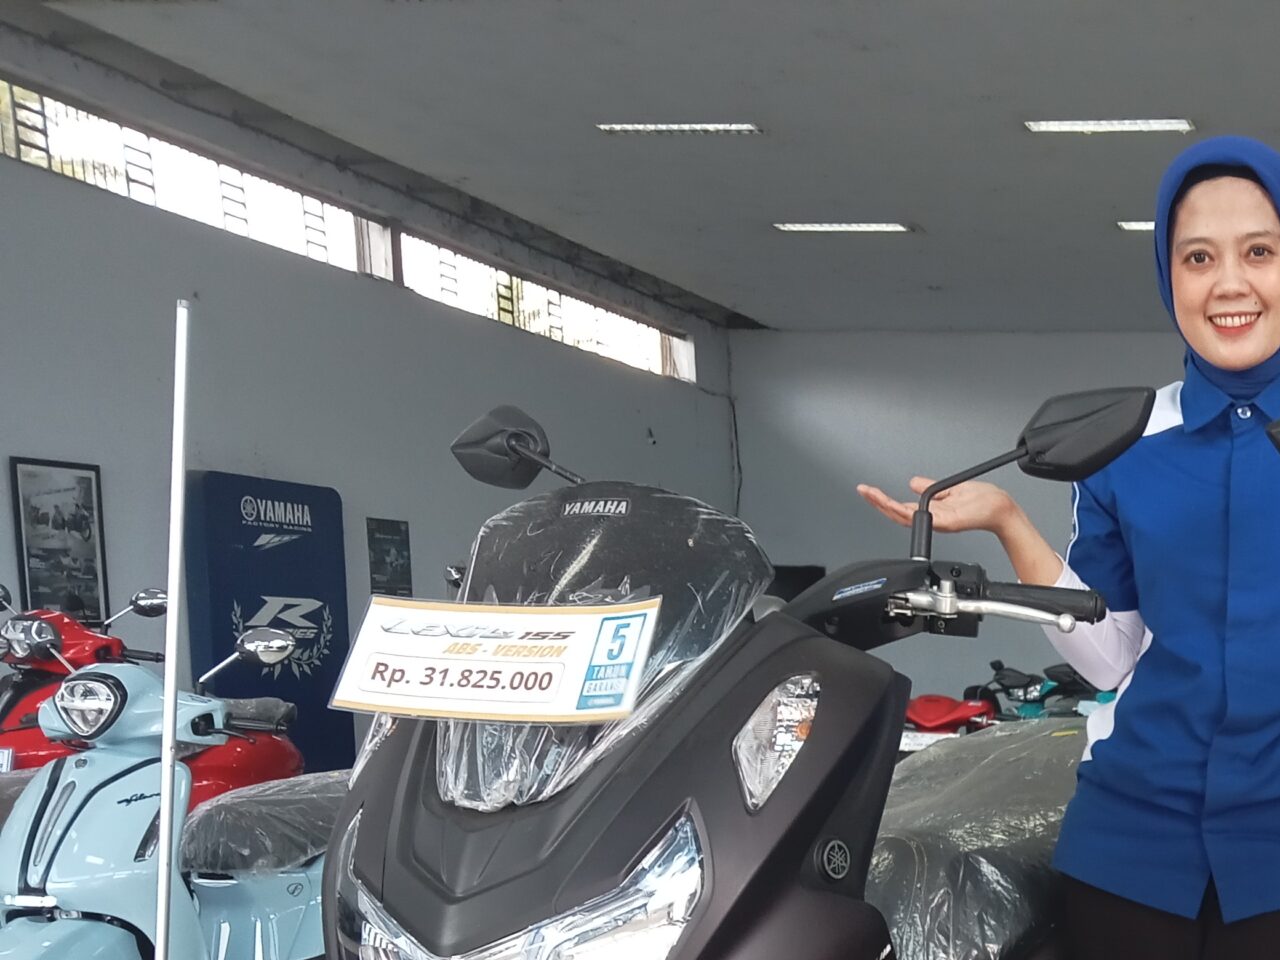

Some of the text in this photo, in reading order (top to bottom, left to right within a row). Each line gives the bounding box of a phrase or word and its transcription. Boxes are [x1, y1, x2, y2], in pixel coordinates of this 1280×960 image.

[257, 499, 312, 526] YAMAHA
[562, 500, 628, 515] YAMAHA
[517, 631, 576, 640] 155
[607, 623, 631, 661] 5
[442, 642, 483, 655] ABS
[492, 643, 568, 658] VERSION
[371, 662, 554, 691] Rp. 31.825.000
